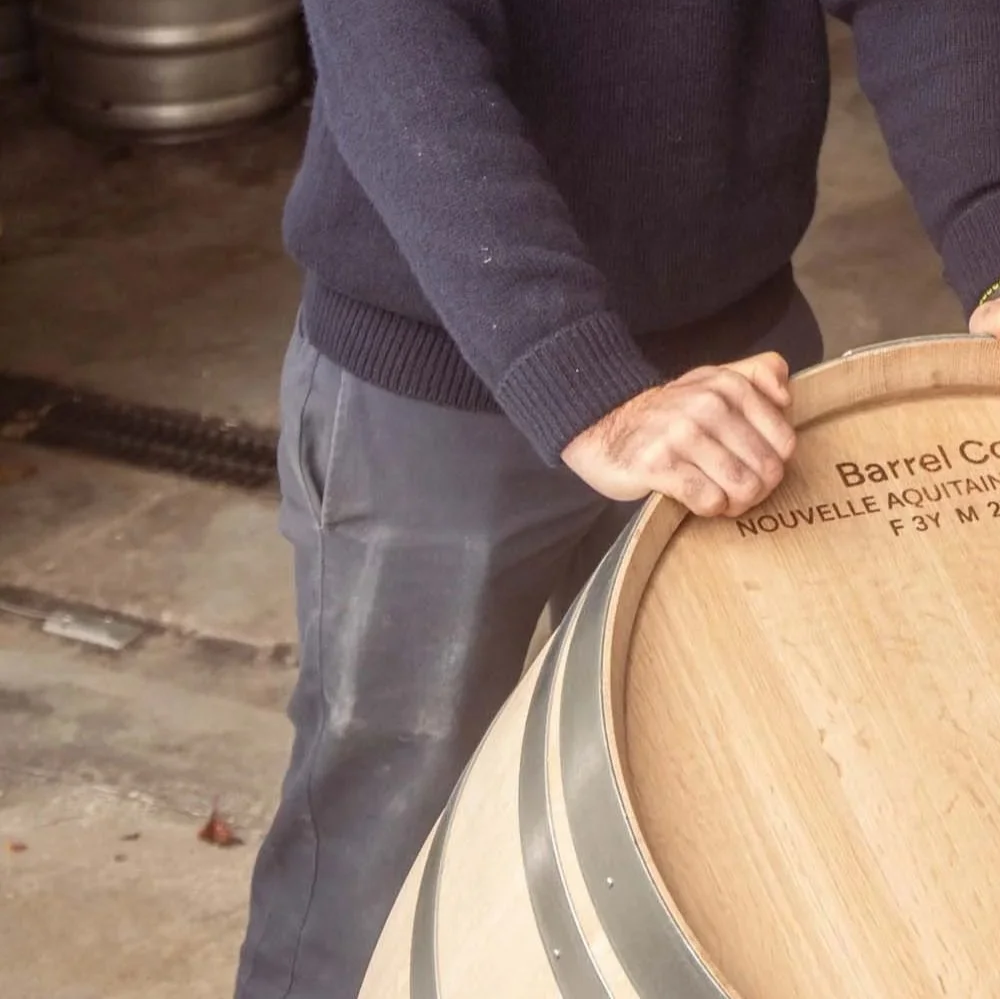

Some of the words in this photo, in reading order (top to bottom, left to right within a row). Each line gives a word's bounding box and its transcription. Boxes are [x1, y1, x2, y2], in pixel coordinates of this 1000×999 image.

[834, 443, 952, 488] Barrel
[735, 495, 881, 538] NOUVELLE
[889, 519, 904, 537] F
[911, 512, 941, 532] 3Y
[955, 505, 980, 524] M
